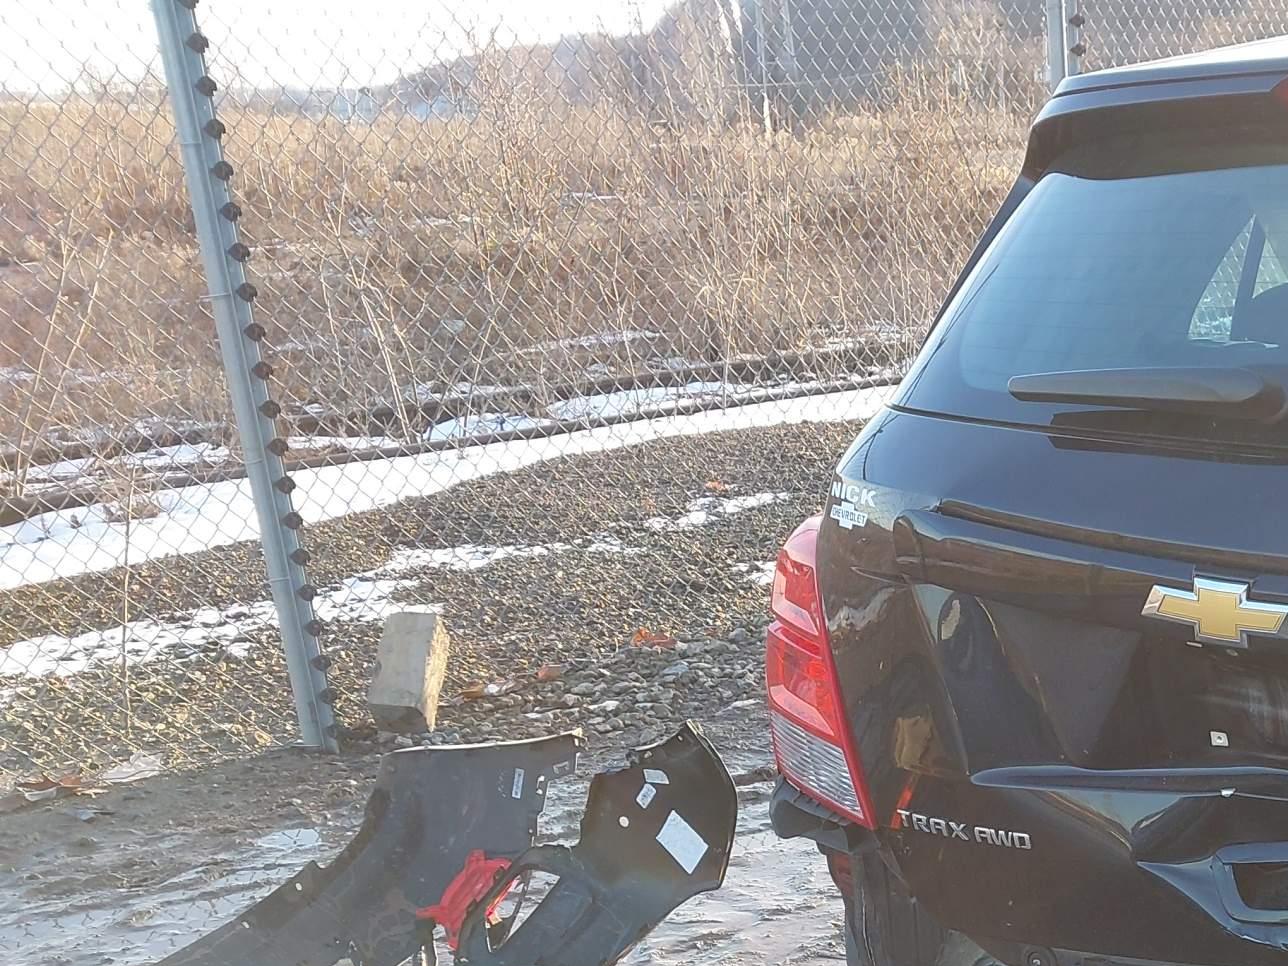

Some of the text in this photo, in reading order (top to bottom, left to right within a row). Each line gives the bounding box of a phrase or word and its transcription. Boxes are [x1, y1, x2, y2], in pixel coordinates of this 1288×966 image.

[831, 481, 876, 507] NICK
[832, 506, 866, 525] CHEVROLET
[896, 809, 1032, 850] TRAX AWD
